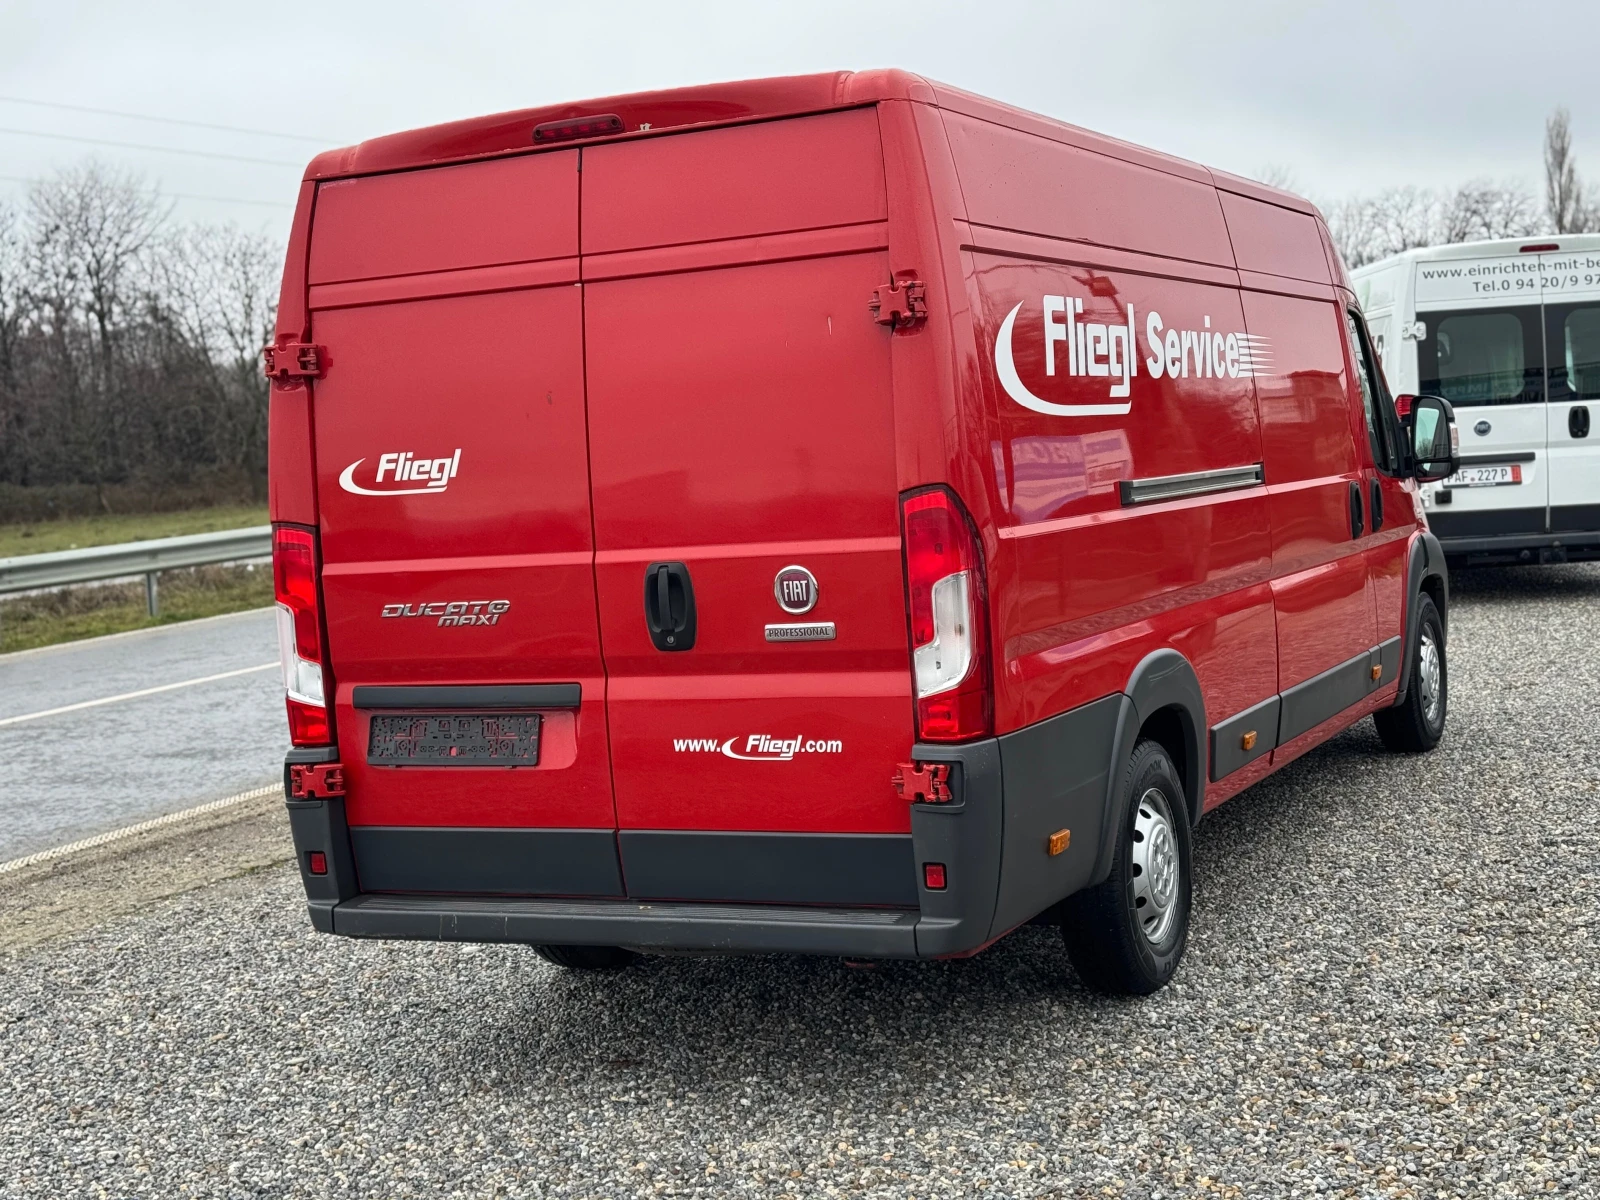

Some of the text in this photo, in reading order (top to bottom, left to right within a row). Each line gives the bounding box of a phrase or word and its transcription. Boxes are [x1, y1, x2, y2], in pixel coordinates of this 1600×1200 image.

[1516, 277, 1535, 290] 94
[1541, 275, 1579, 290] 20/9
[1043, 294, 1240, 398] Fliegl Service
[375, 448, 462, 487] Fliegl
[1477, 468, 1498, 482] 227
[1501, 468, 1508, 480] P
[783, 580, 807, 602] FIAT
[381, 599, 511, 617] DUCATO
[437, 614, 500, 627] MAXI
[768, 627, 830, 638] PROFESSIONAL
